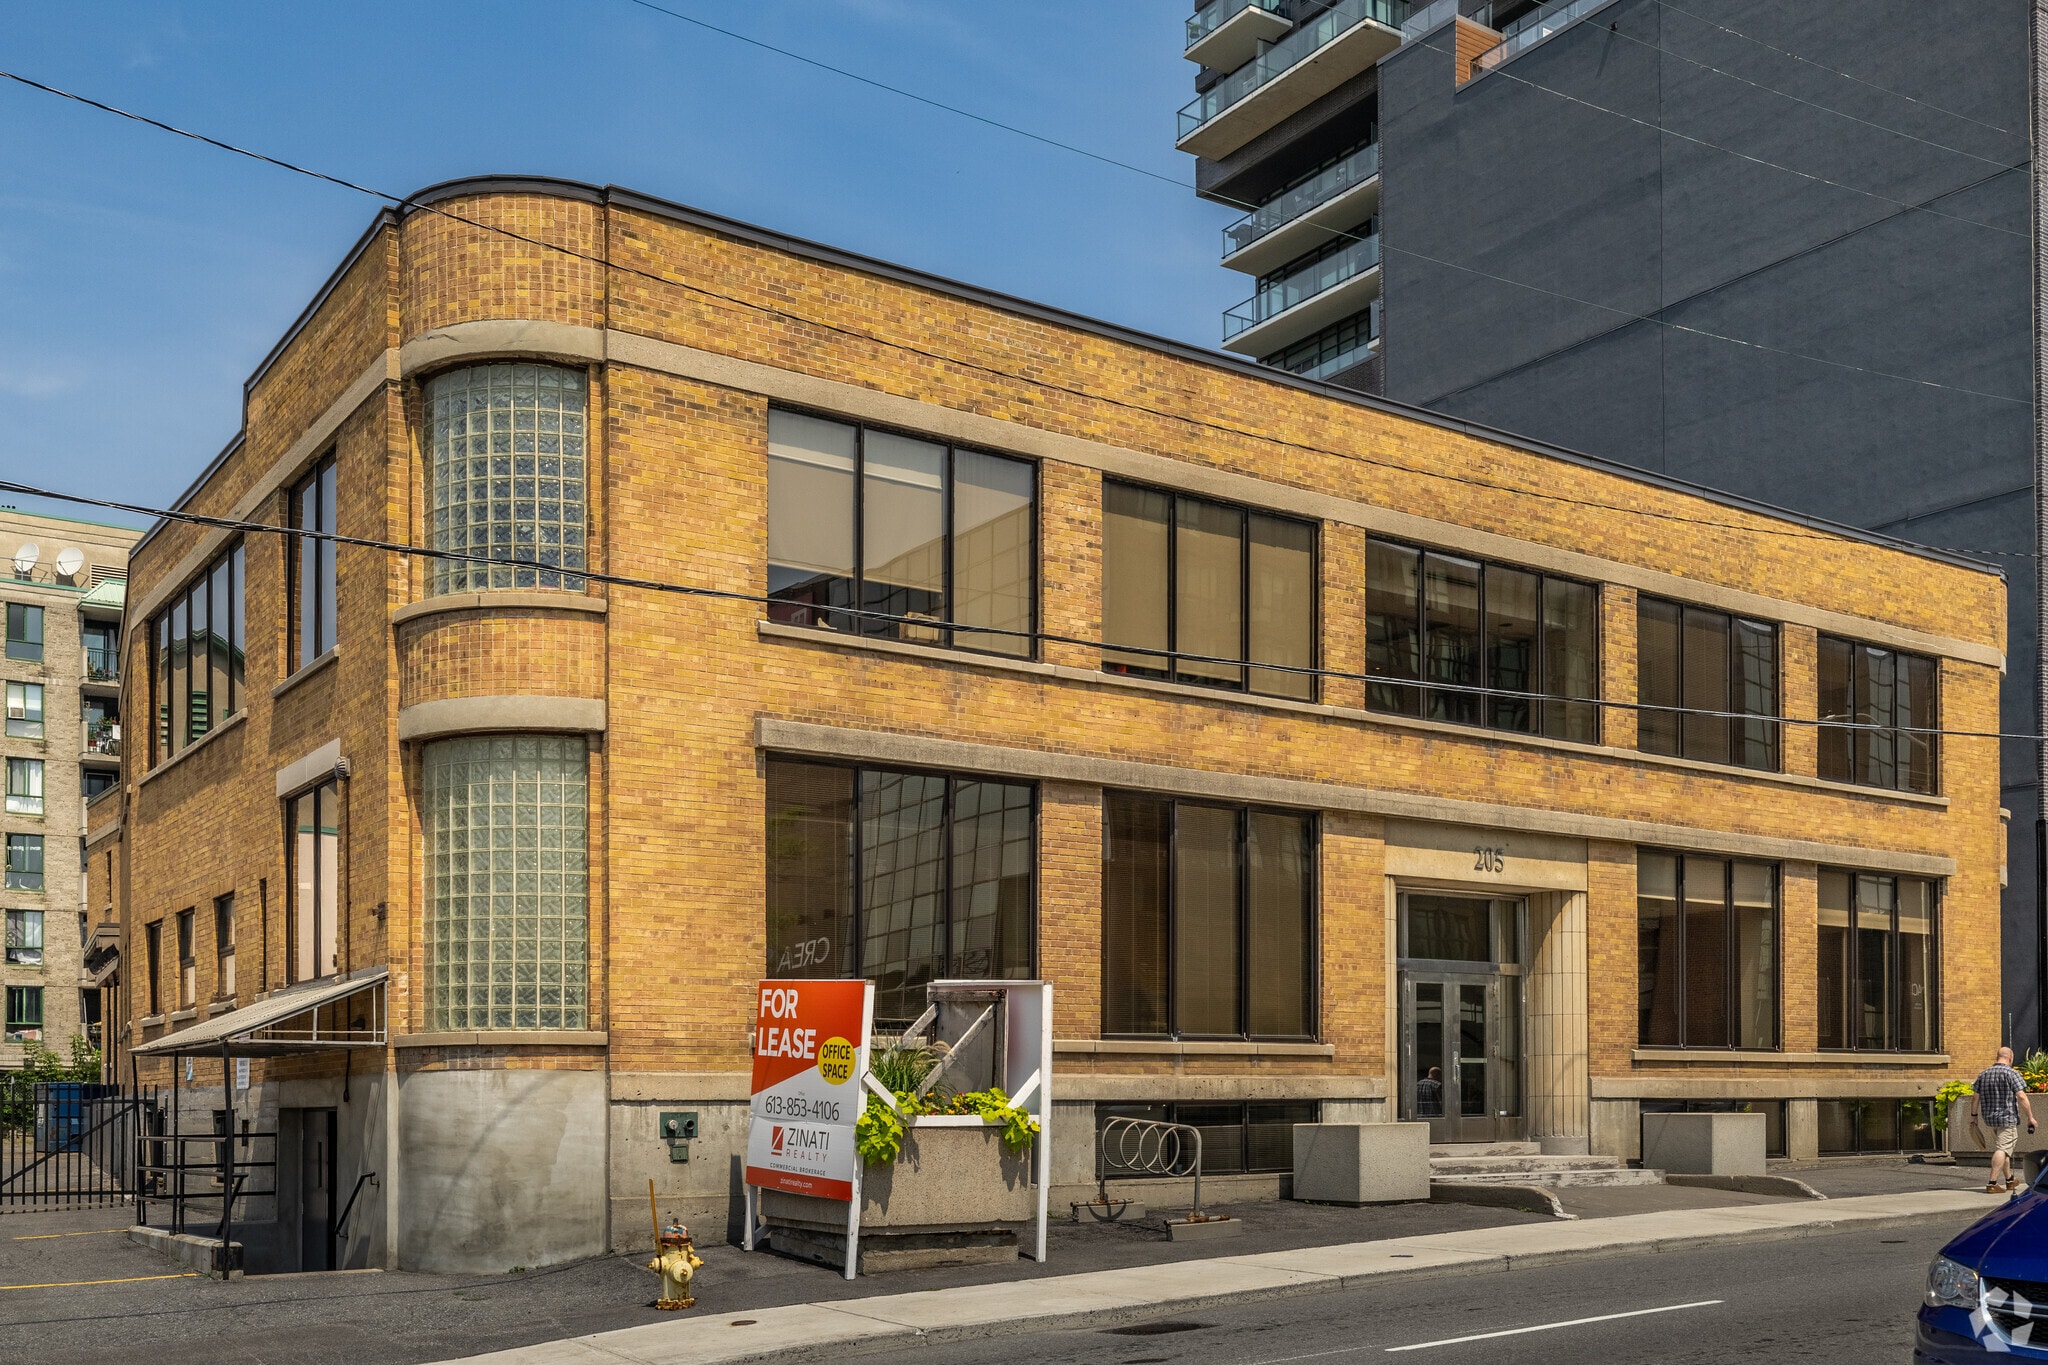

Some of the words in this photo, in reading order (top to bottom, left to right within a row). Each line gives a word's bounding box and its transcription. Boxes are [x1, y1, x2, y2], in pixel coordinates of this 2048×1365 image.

[1473, 846, 1504, 873] 205
[760, 989, 798, 1018] FOR
[757, 1027, 816, 1059] LEASE
[822, 1043, 850, 1060] OFFICE
[822, 1063, 848, 1080] SPACE
[765, 1095, 840, 1121] 613-853-4106
[787, 1128, 830, 1150] ZINATI
[786, 1148, 828, 1163] REALTY
[770, 1163, 798, 1172] COMMERCIAL
[799, 1167, 826, 1176] BROKERAGE
[780, 1178, 813, 1188] zinatirealty.com
